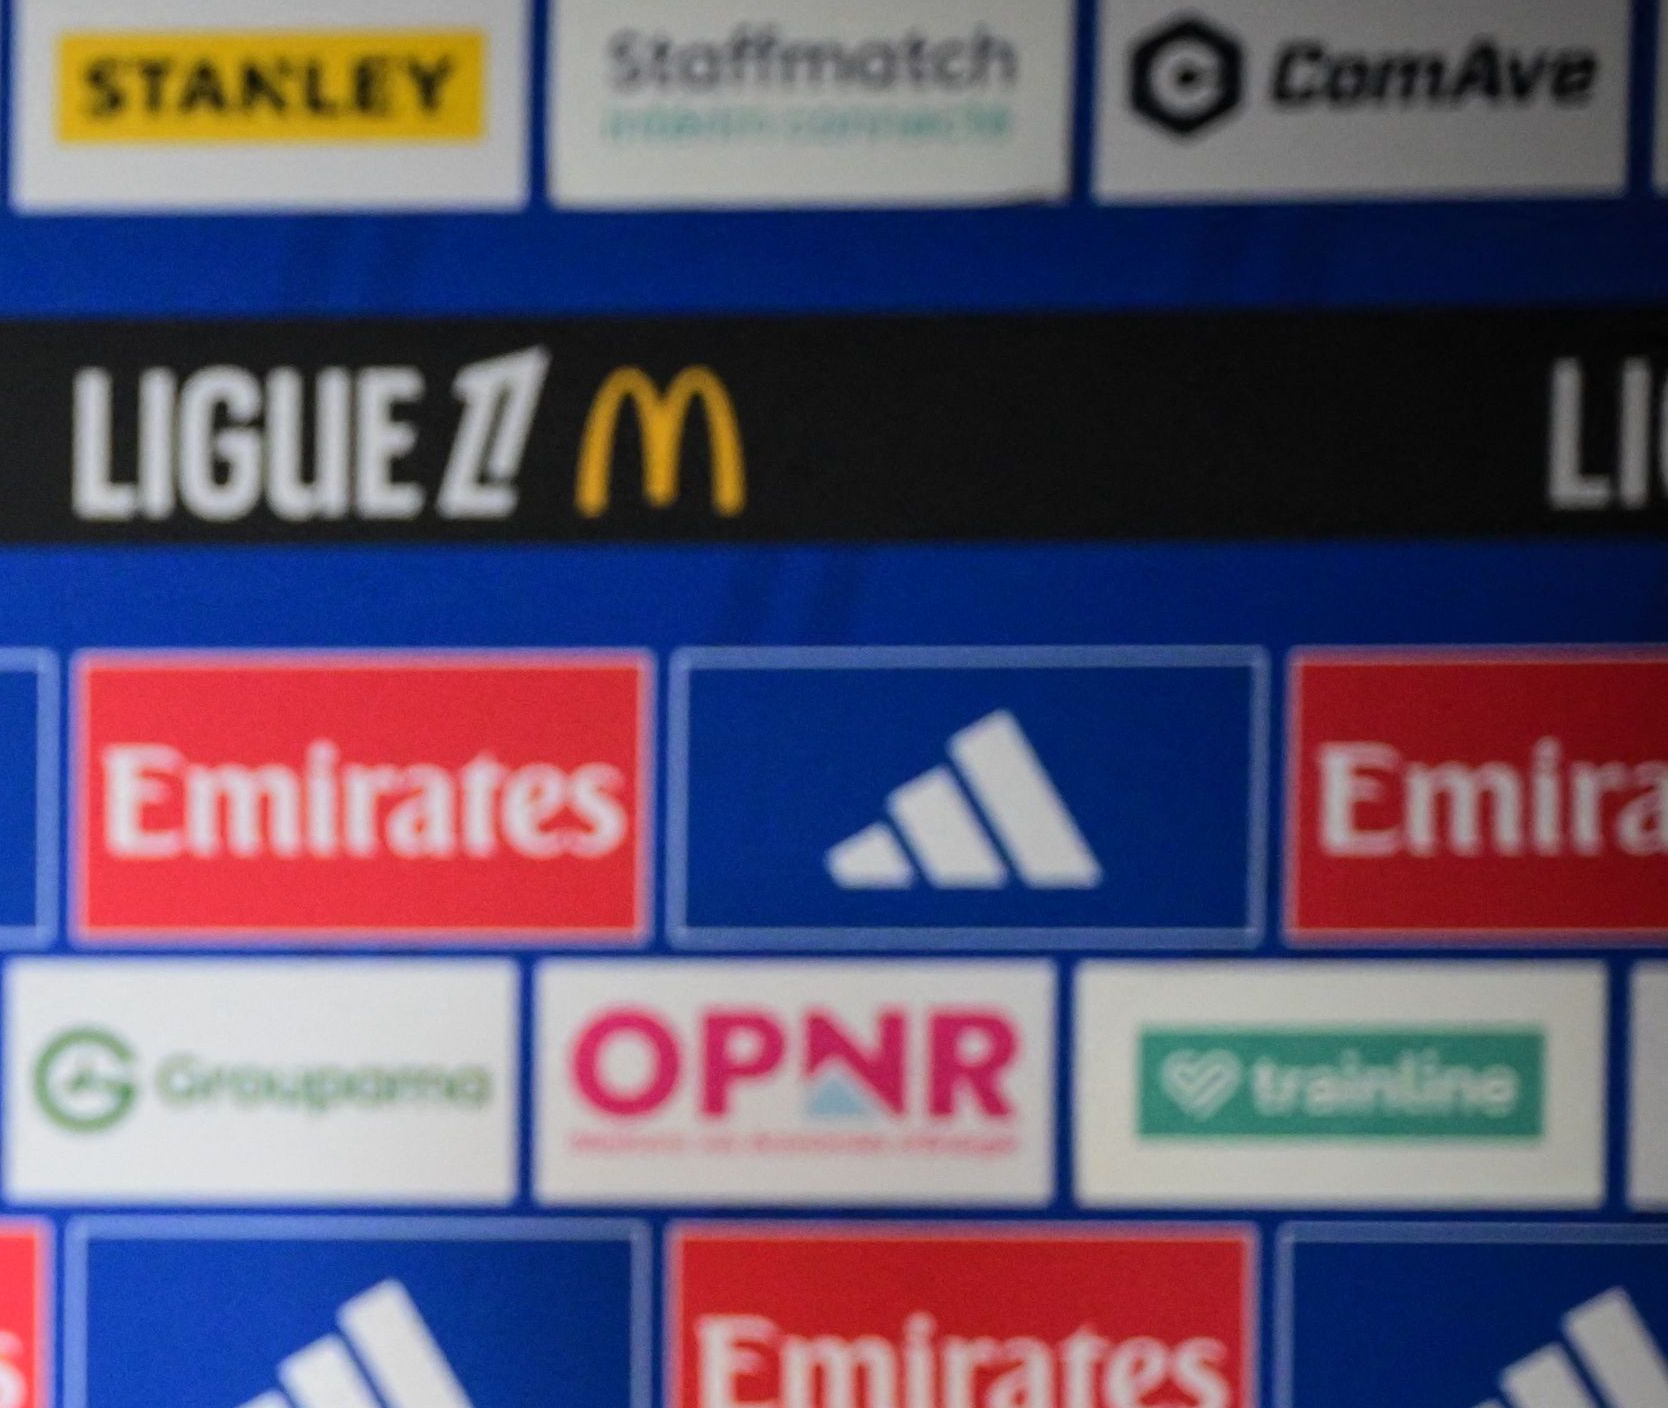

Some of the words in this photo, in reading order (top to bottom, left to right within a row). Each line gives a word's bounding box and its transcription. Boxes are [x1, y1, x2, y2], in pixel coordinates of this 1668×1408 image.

[85, 55, 455, 118] STANLEY
[610, 21, 1021, 92] Staffmatch
[1271, 38, 1601, 107] ComAve
[72, 366, 423, 521] LIGUE
[102, 741, 625, 858] Emirates
[1317, 740, 1668, 856] Emira
[155, 1056, 493, 1113] Groupama
[570, 1007, 1021, 1121] OPNR
[1252, 1056, 1519, 1117] trainline
